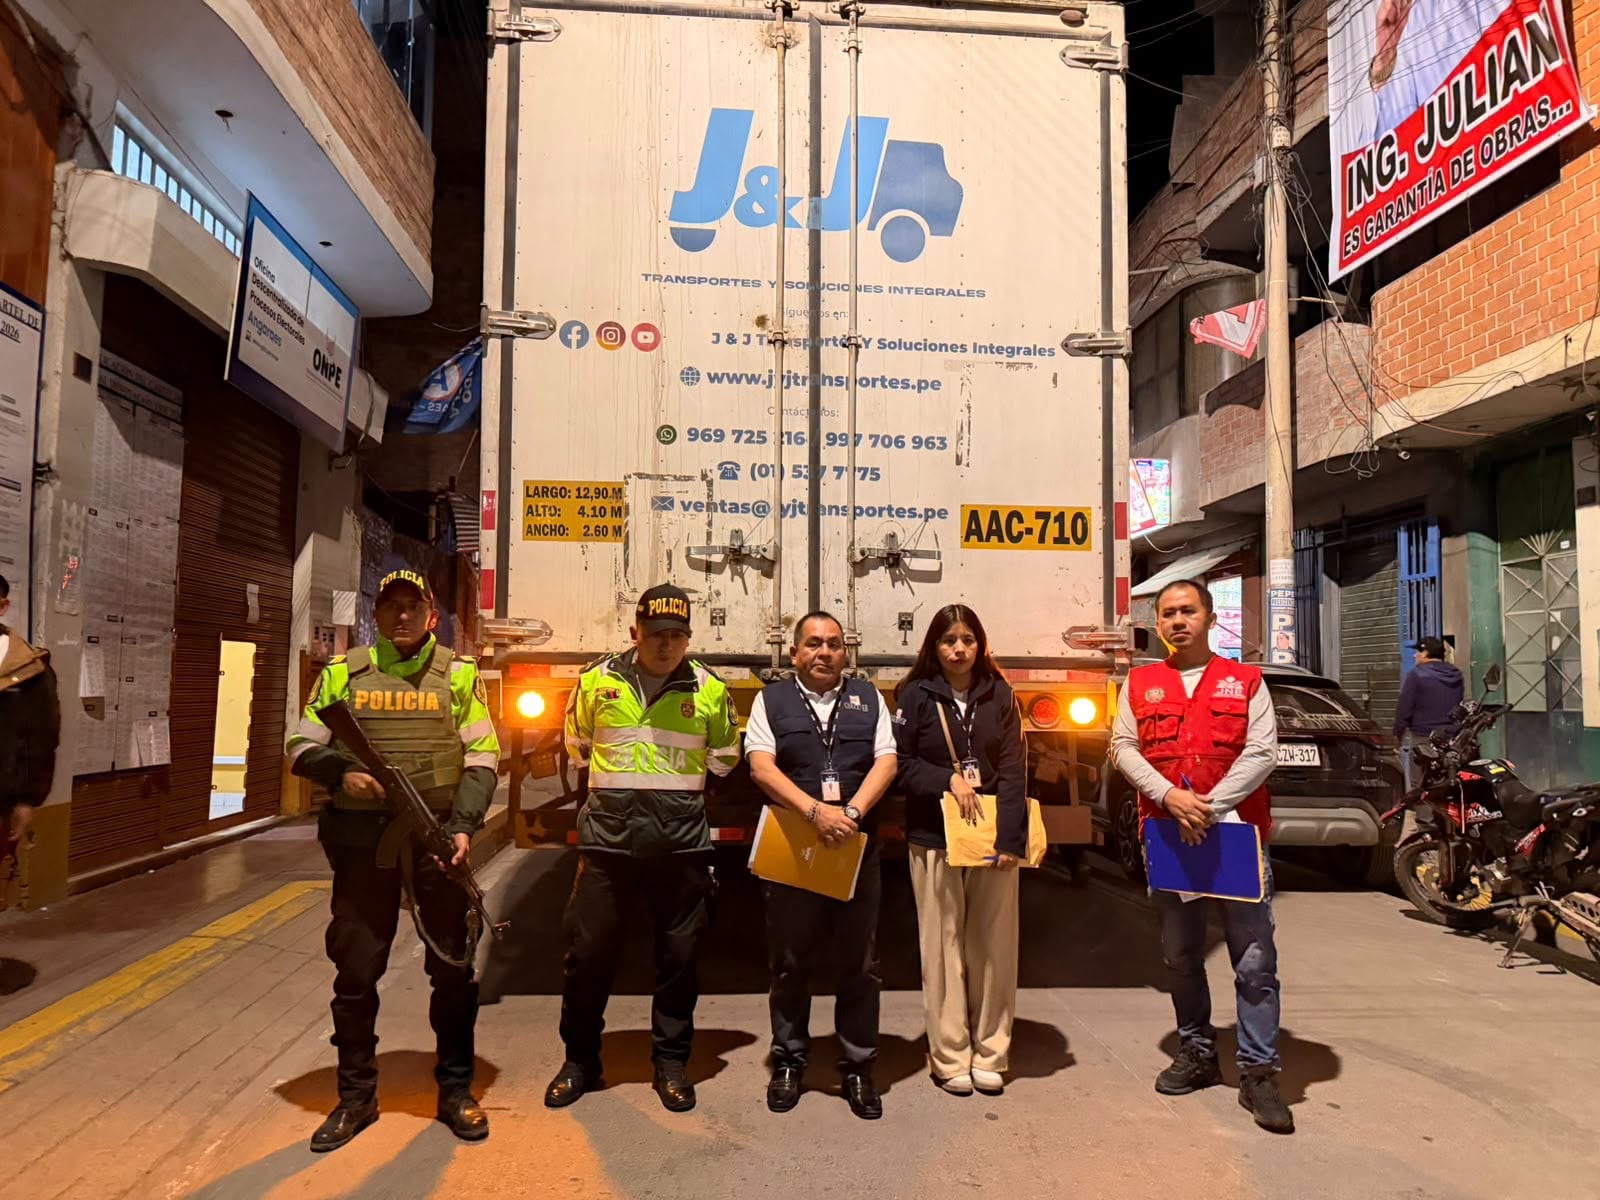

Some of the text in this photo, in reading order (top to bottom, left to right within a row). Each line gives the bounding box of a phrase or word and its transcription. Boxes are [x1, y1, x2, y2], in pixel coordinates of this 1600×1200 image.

[1347, 9, 1559, 213] ING. JULIAN
[1343, 99, 1571, 257] ES GARANTÍA DE OBRAS...
[254, 256, 275, 283] Oficina
[641, 273, 762, 288] TRANSPORTES
[888, 285, 986, 298] INTEGRALES
[0, 298, 26, 322] RTEL
[249, 290, 305, 345] Procesos Electorales
[1, 320, 20, 340] 2026
[247, 310, 282, 347] Angaraes
[711, 332, 721, 344] J
[725, 333, 738, 345] &
[742, 333, 751, 345] J
[863, 337, 873, 349] Y
[877, 338, 968, 353] Soluciones
[972, 342, 1056, 358] Integrales
[312, 348, 342, 389] ONPE
[687, 427, 725, 443] 969
[732, 429, 767, 444] 725
[868, 434, 906, 449] 706
[911, 436, 947, 451] 963
[525, 486, 622, 501] LARGO: 12,90 M
[526, 504, 622, 518] ALTO: 4.10 M
[526, 524, 622, 537] ANCHO: 2.60 M
[964, 509, 1089, 545] AAC-710
[379, 570, 424, 591] POLICIA
[649, 598, 688, 617] POLICIA
[354, 690, 439, 711] POLICIA
